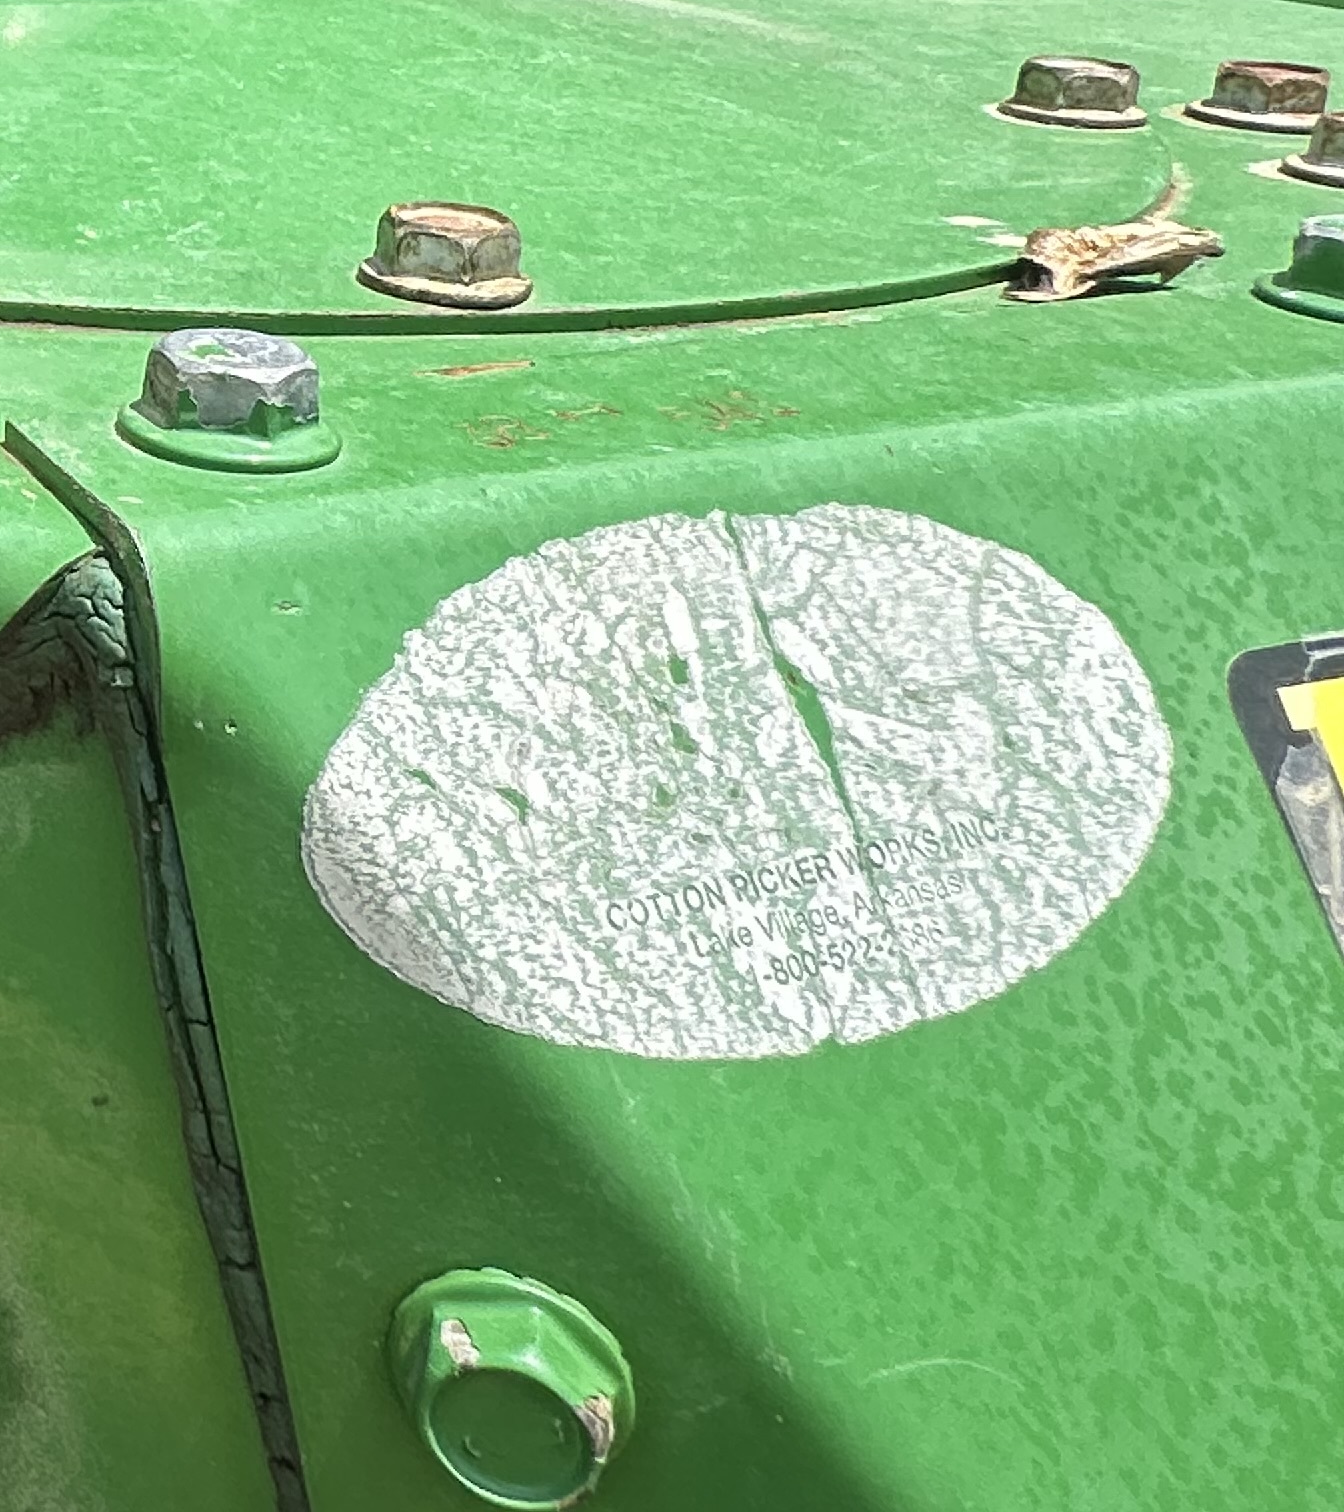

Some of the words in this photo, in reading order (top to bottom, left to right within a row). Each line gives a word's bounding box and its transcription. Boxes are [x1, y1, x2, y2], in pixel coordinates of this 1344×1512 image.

[606, 876, 727, 931] COTTON
[728, 854, 838, 903] PICKER
[950, 815, 1010, 850] INC.
[687, 922, 754, 958] Lake
[753, 904, 852, 941] Village,
[852, 873, 963, 919] Arkansas
